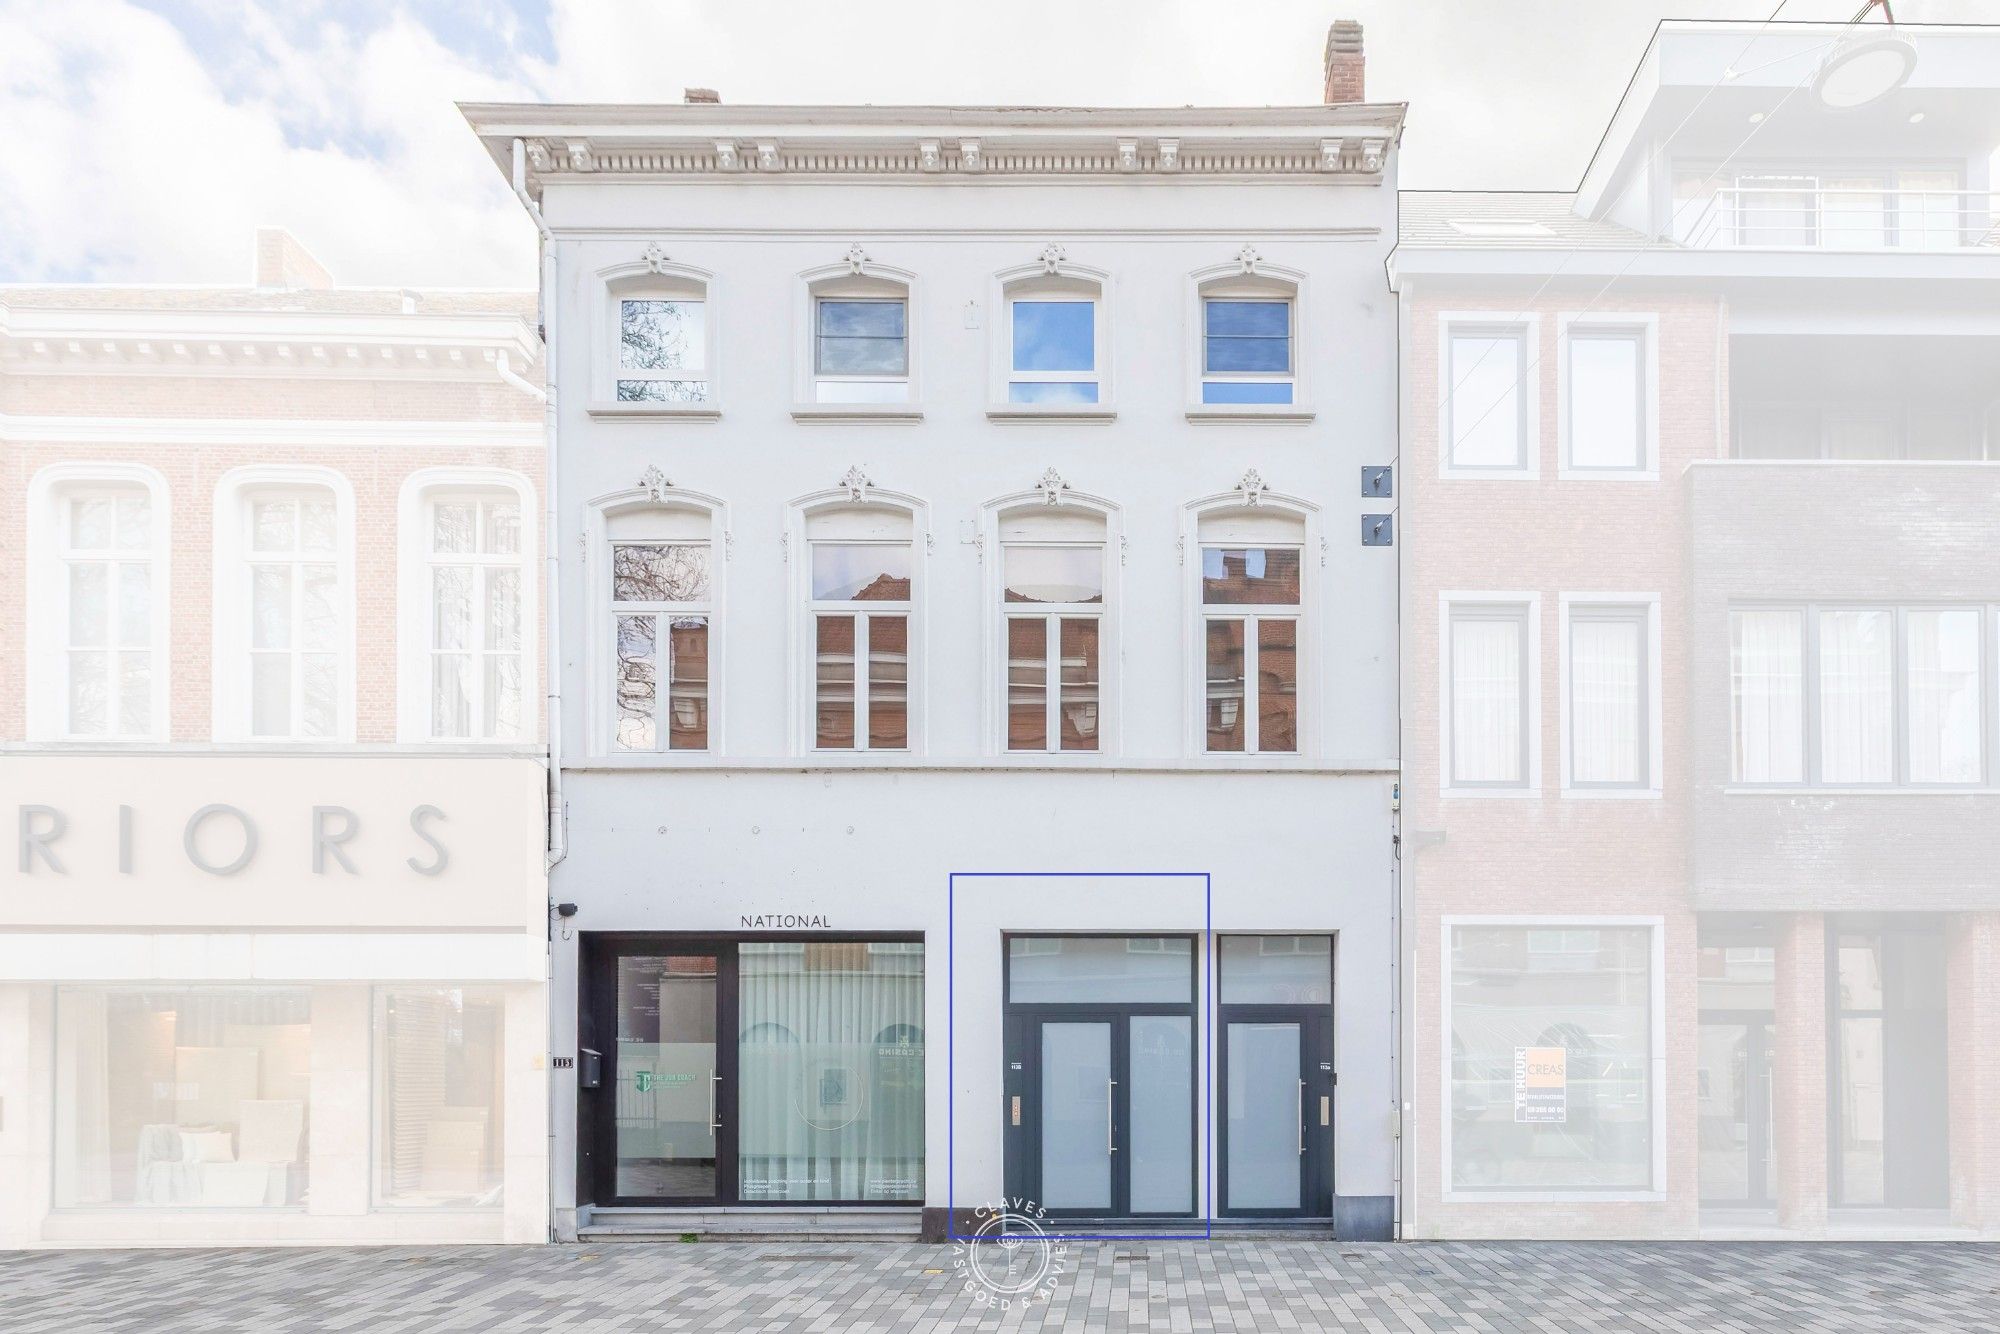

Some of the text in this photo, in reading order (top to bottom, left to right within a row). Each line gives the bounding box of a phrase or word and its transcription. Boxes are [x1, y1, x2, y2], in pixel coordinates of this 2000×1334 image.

[18, 803, 448, 876] RIORS
[741, 915, 831, 928] NATIONAL
[1516, 1050, 1526, 1110] TE HUUR
[1527, 1063, 1564, 1075] CREAS
